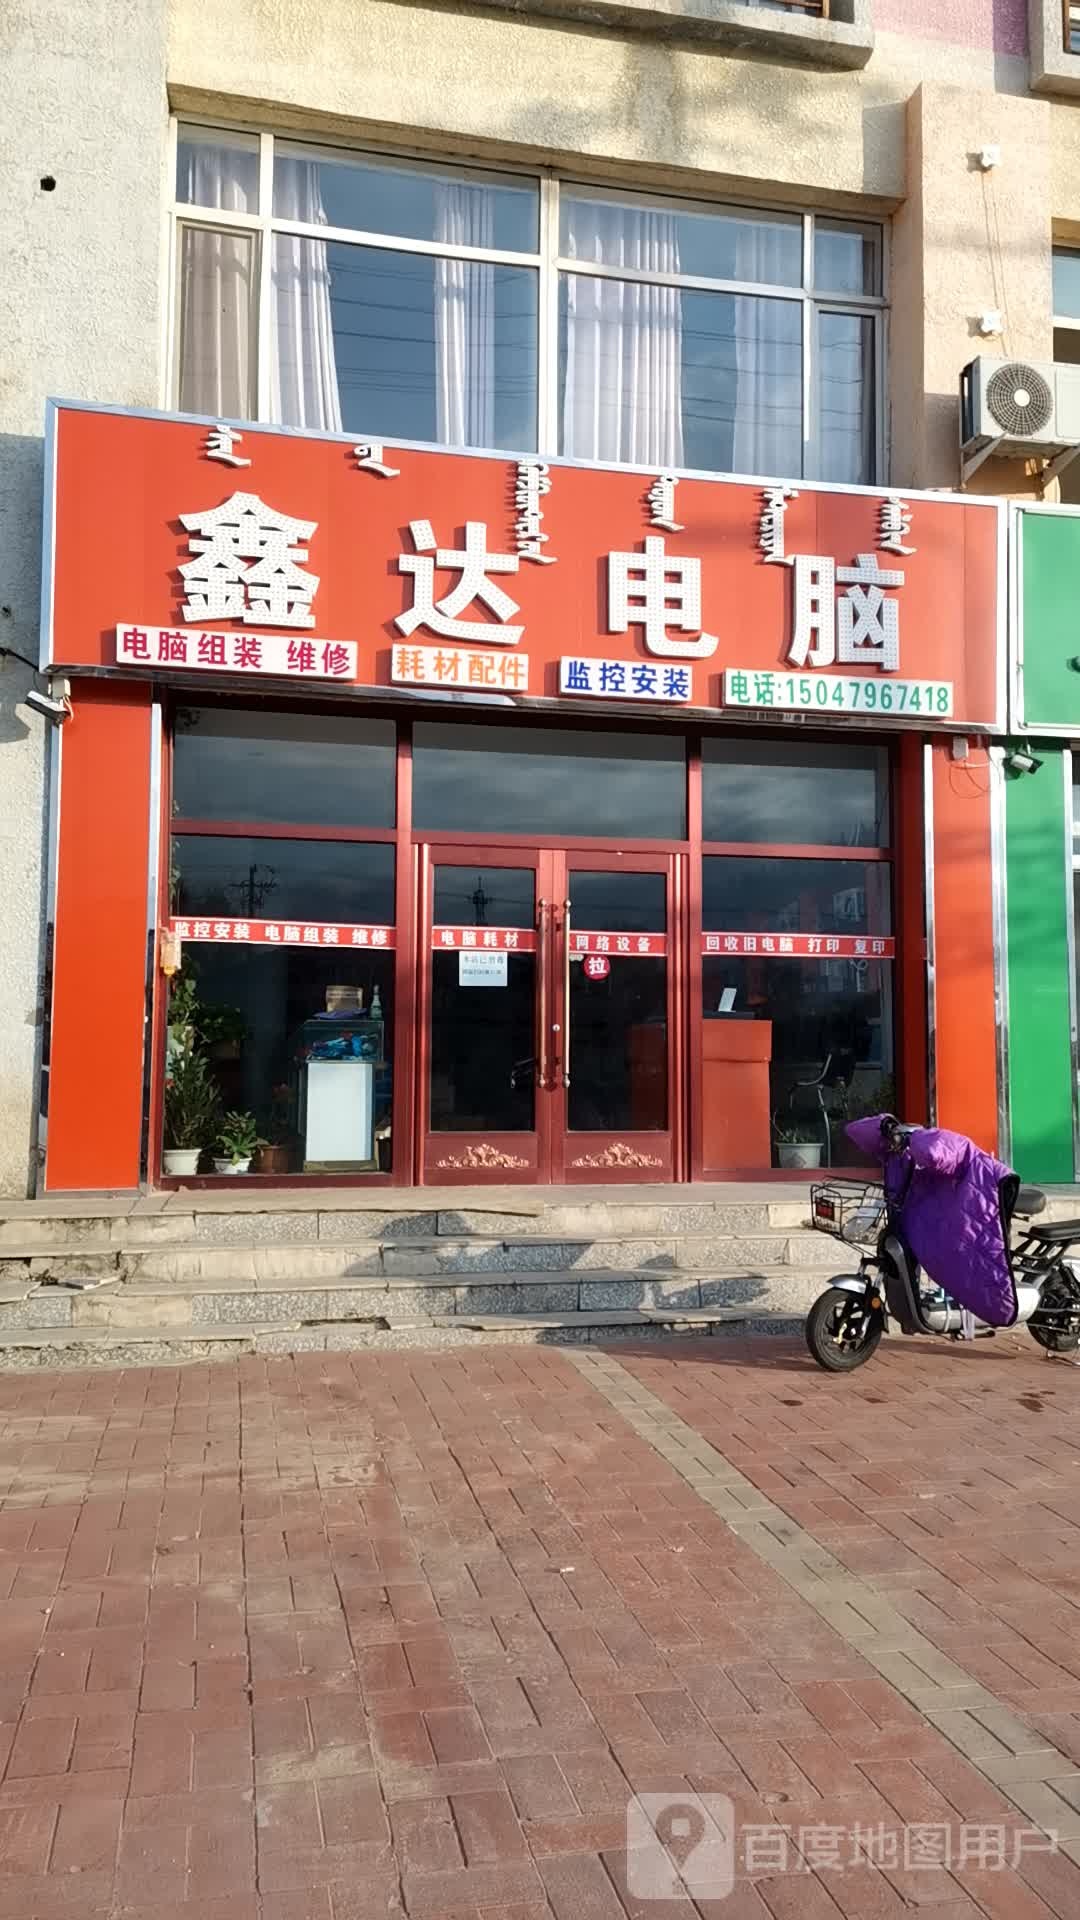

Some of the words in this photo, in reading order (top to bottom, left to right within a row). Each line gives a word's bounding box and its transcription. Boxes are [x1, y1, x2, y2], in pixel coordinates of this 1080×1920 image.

[178, 491, 905, 672] 鑫达电脑
[122, 627, 264, 670] 电脑组装
[287, 640, 352, 675] 维修
[396, 648, 526, 687] 耗材配件
[564, 661, 690, 699] 监控安装
[730, 671, 950, 713] 电话:15047967418
[174, 921, 251, 940] 监控安装
[264, 924, 340, 944] 电脑组装
[352, 929, 388, 946] 维修
[441, 930, 519, 948] 电脑耗材
[575, 935, 651, 953] 网络设备
[706, 935, 794, 953] 回收旧电脑
[808, 937, 840, 953] 打印
[854, 938, 886, 955] 复印
[588, 957, 608, 975] 拉
